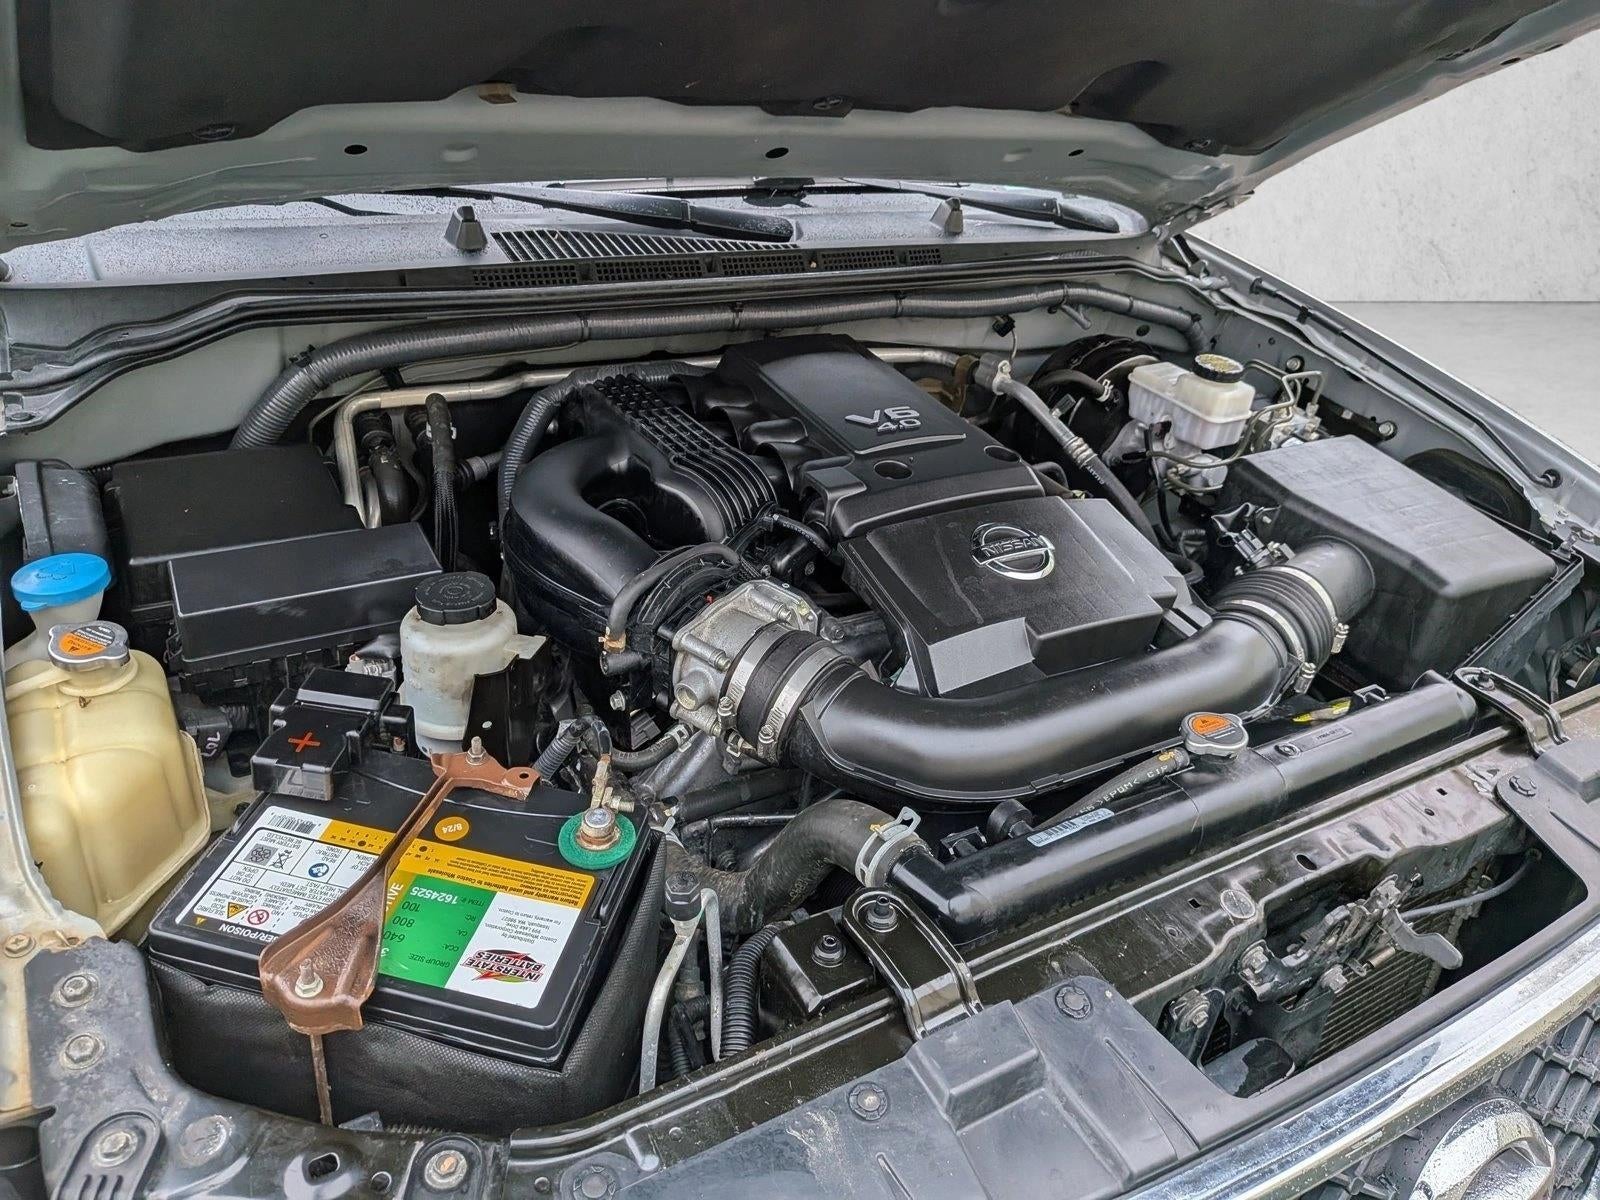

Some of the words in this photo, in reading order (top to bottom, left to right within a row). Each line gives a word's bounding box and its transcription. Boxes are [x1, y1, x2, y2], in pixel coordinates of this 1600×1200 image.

[845, 406, 920, 425] V6
[878, 418, 921, 433] 4.0
[981, 537, 1044, 557] NISSAN
[442, 823, 461, 833] 8/24
[427, 868, 456, 879] Wholesale
[456, 875, 476, 884] Costco
[483, 881, 508, 891] batteries
[508, 886, 523, 894] used
[409, 886, 460, 905] 1624525
[536, 891, 559, 901] warranty
[559, 897, 578, 905] Return
[401, 900, 421, 912] 100
[392, 915, 415, 928] 800
[382, 930, 406, 943] 640
[454, 929, 468, 937] CA:
[442, 943, 460, 952] CCA:
[407, 953, 426, 962] SIZE:
[426, 957, 451, 968] GROUP
[476, 951, 542, 972] BATTERIES
[466, 958, 540, 982] INTERSTATE
